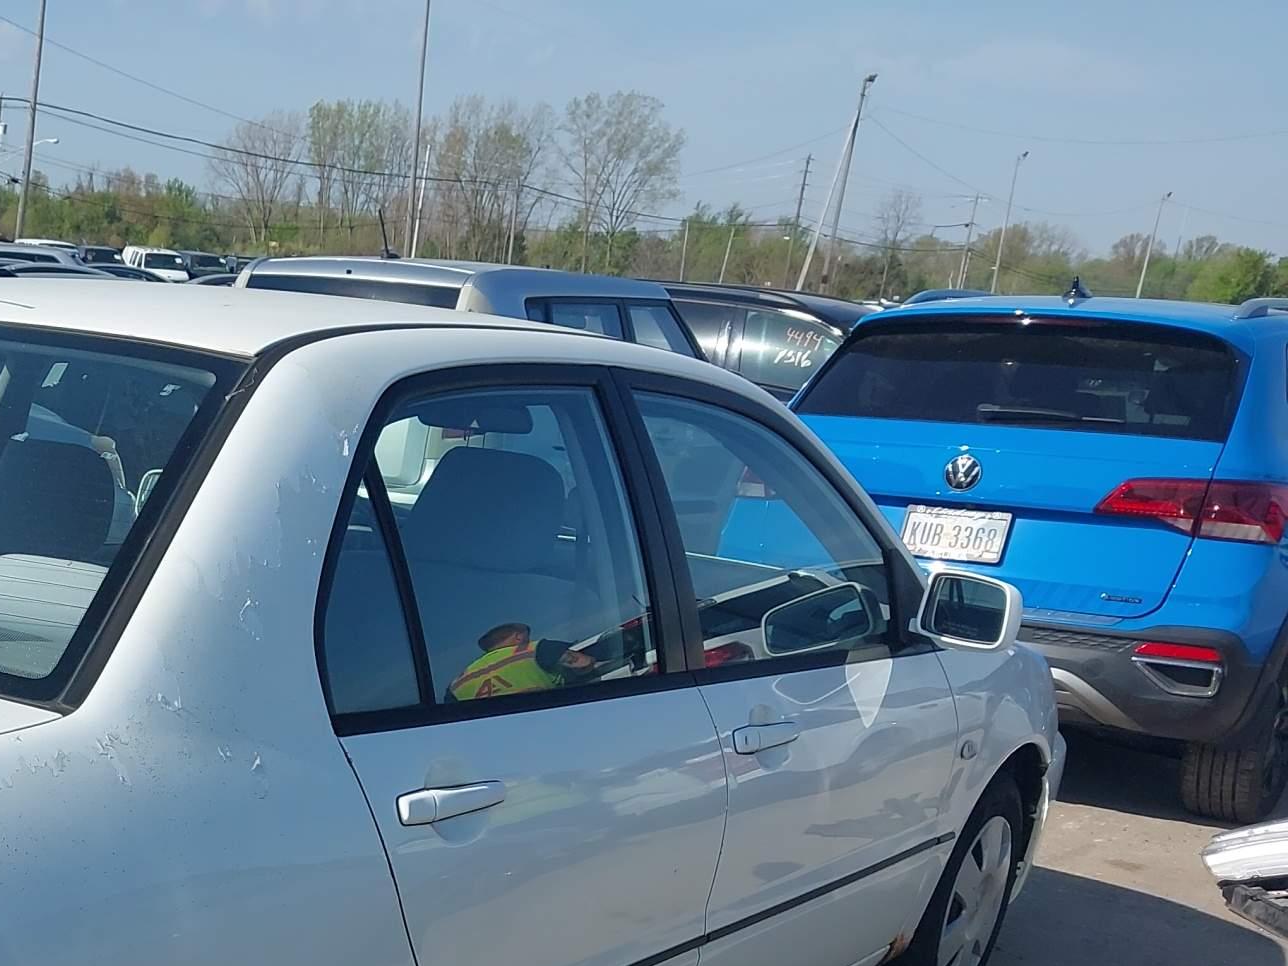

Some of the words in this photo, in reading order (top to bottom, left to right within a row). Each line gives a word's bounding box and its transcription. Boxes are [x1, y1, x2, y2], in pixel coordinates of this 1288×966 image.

[786, 328, 825, 351] 4494
[907, 520, 944, 547] KUB
[948, 524, 998, 551] 3368
